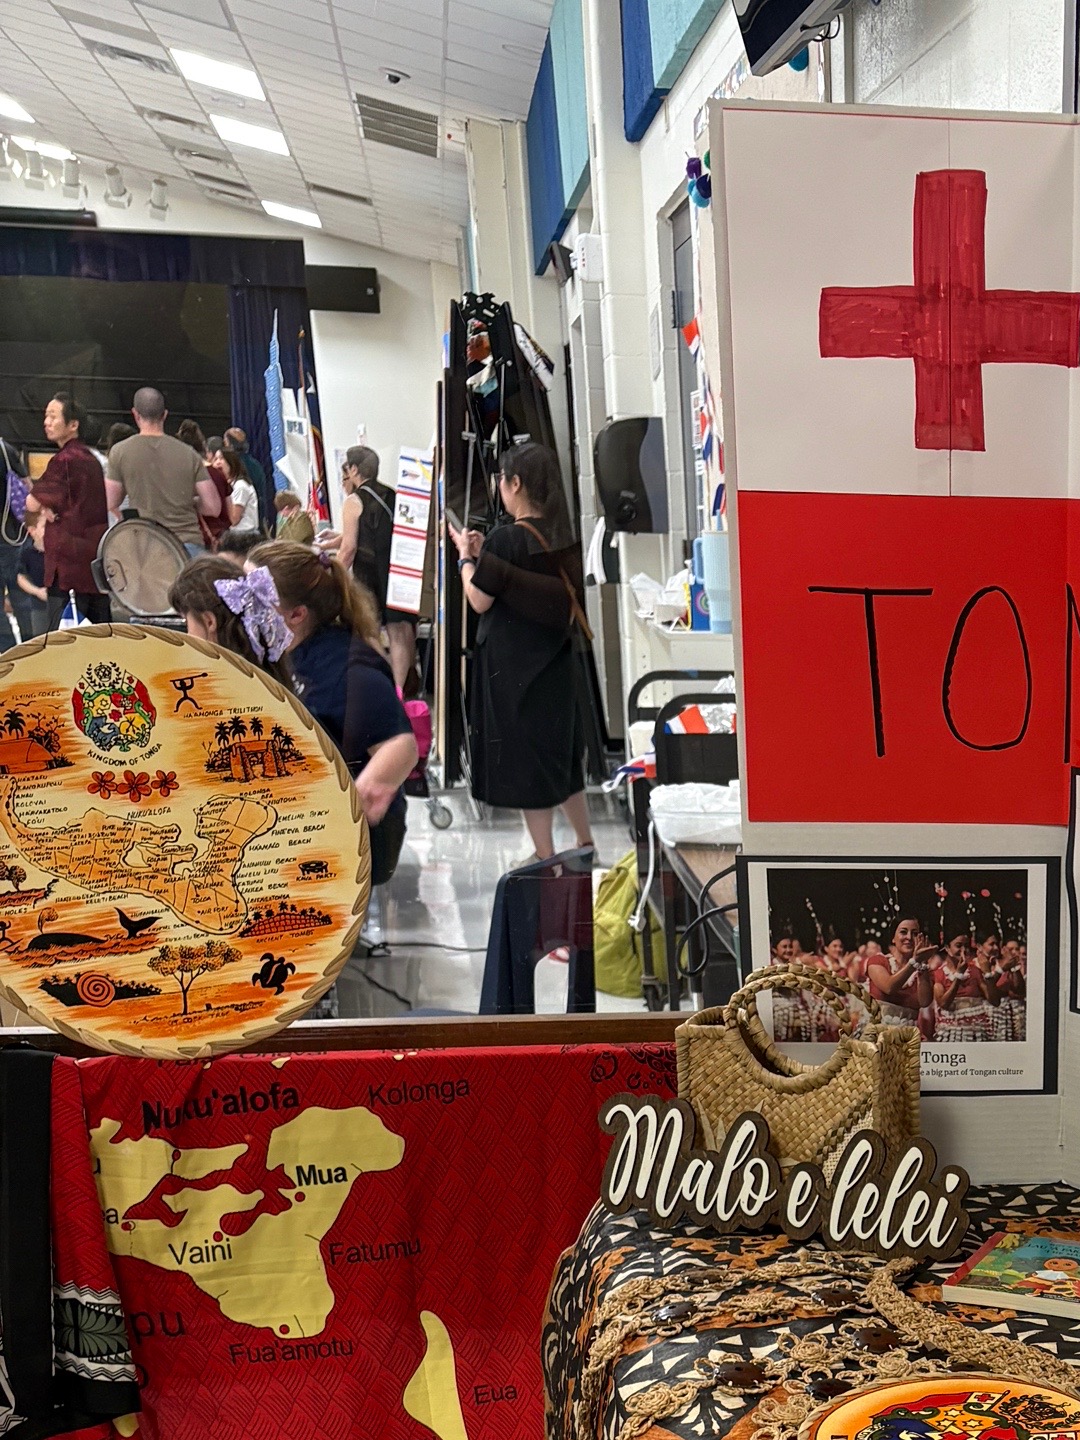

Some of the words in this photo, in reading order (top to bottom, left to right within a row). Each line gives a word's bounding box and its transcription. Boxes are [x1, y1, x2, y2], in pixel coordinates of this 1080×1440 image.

[86, 749, 128, 767] KINGDOM
[129, 757, 140, 766] OF
[139, 741, 163, 762] TONGA
[921, 1051, 967, 1067] Tonga
[931, 1068, 943, 1077] big
[944, 1069, 959, 1077] part
[960, 1068, 969, 1076] of
[969, 1068, 998, 1077] Tongan
[998, 1067, 1024, 1076] culture
[367, 1078, 471, 1109] Kolonga
[142, 1082, 300, 1135] Nuku'alofa
[296, 1163, 348, 1189] Mua
[603, 1103, 778, 1220] Malo
[786, 1169, 820, 1229] e
[827, 1138, 961, 1250] lelei
[168, 1239, 234, 1266] Vaini
[329, 1234, 423, 1266] Fatumu
[228, 1337, 354, 1365] Fua'amotu
[474, 1381, 519, 1406] Eua
